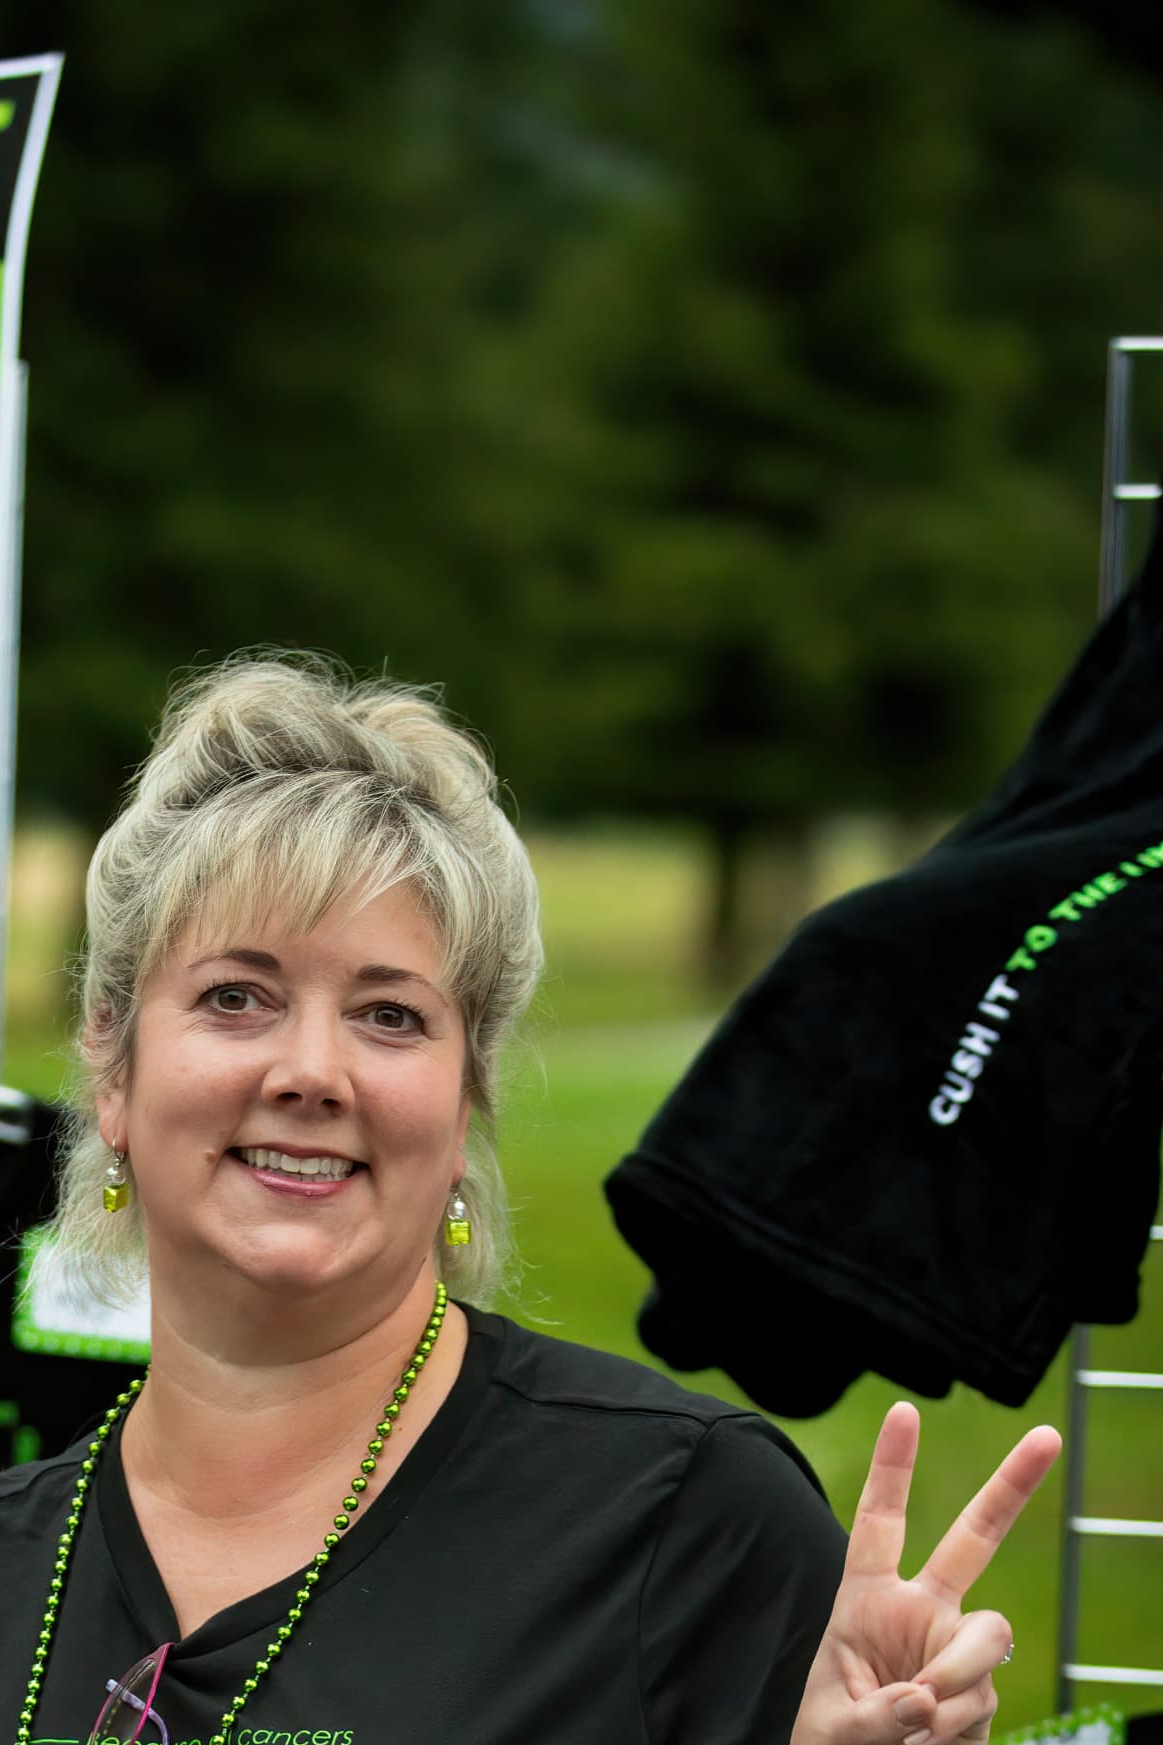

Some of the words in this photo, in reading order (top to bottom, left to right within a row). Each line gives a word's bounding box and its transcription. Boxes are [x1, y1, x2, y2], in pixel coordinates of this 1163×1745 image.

[928, 1022, 1000, 1126] CUSH
[977, 973, 1020, 1020] IT
[1005, 924, 1059, 972] TO
